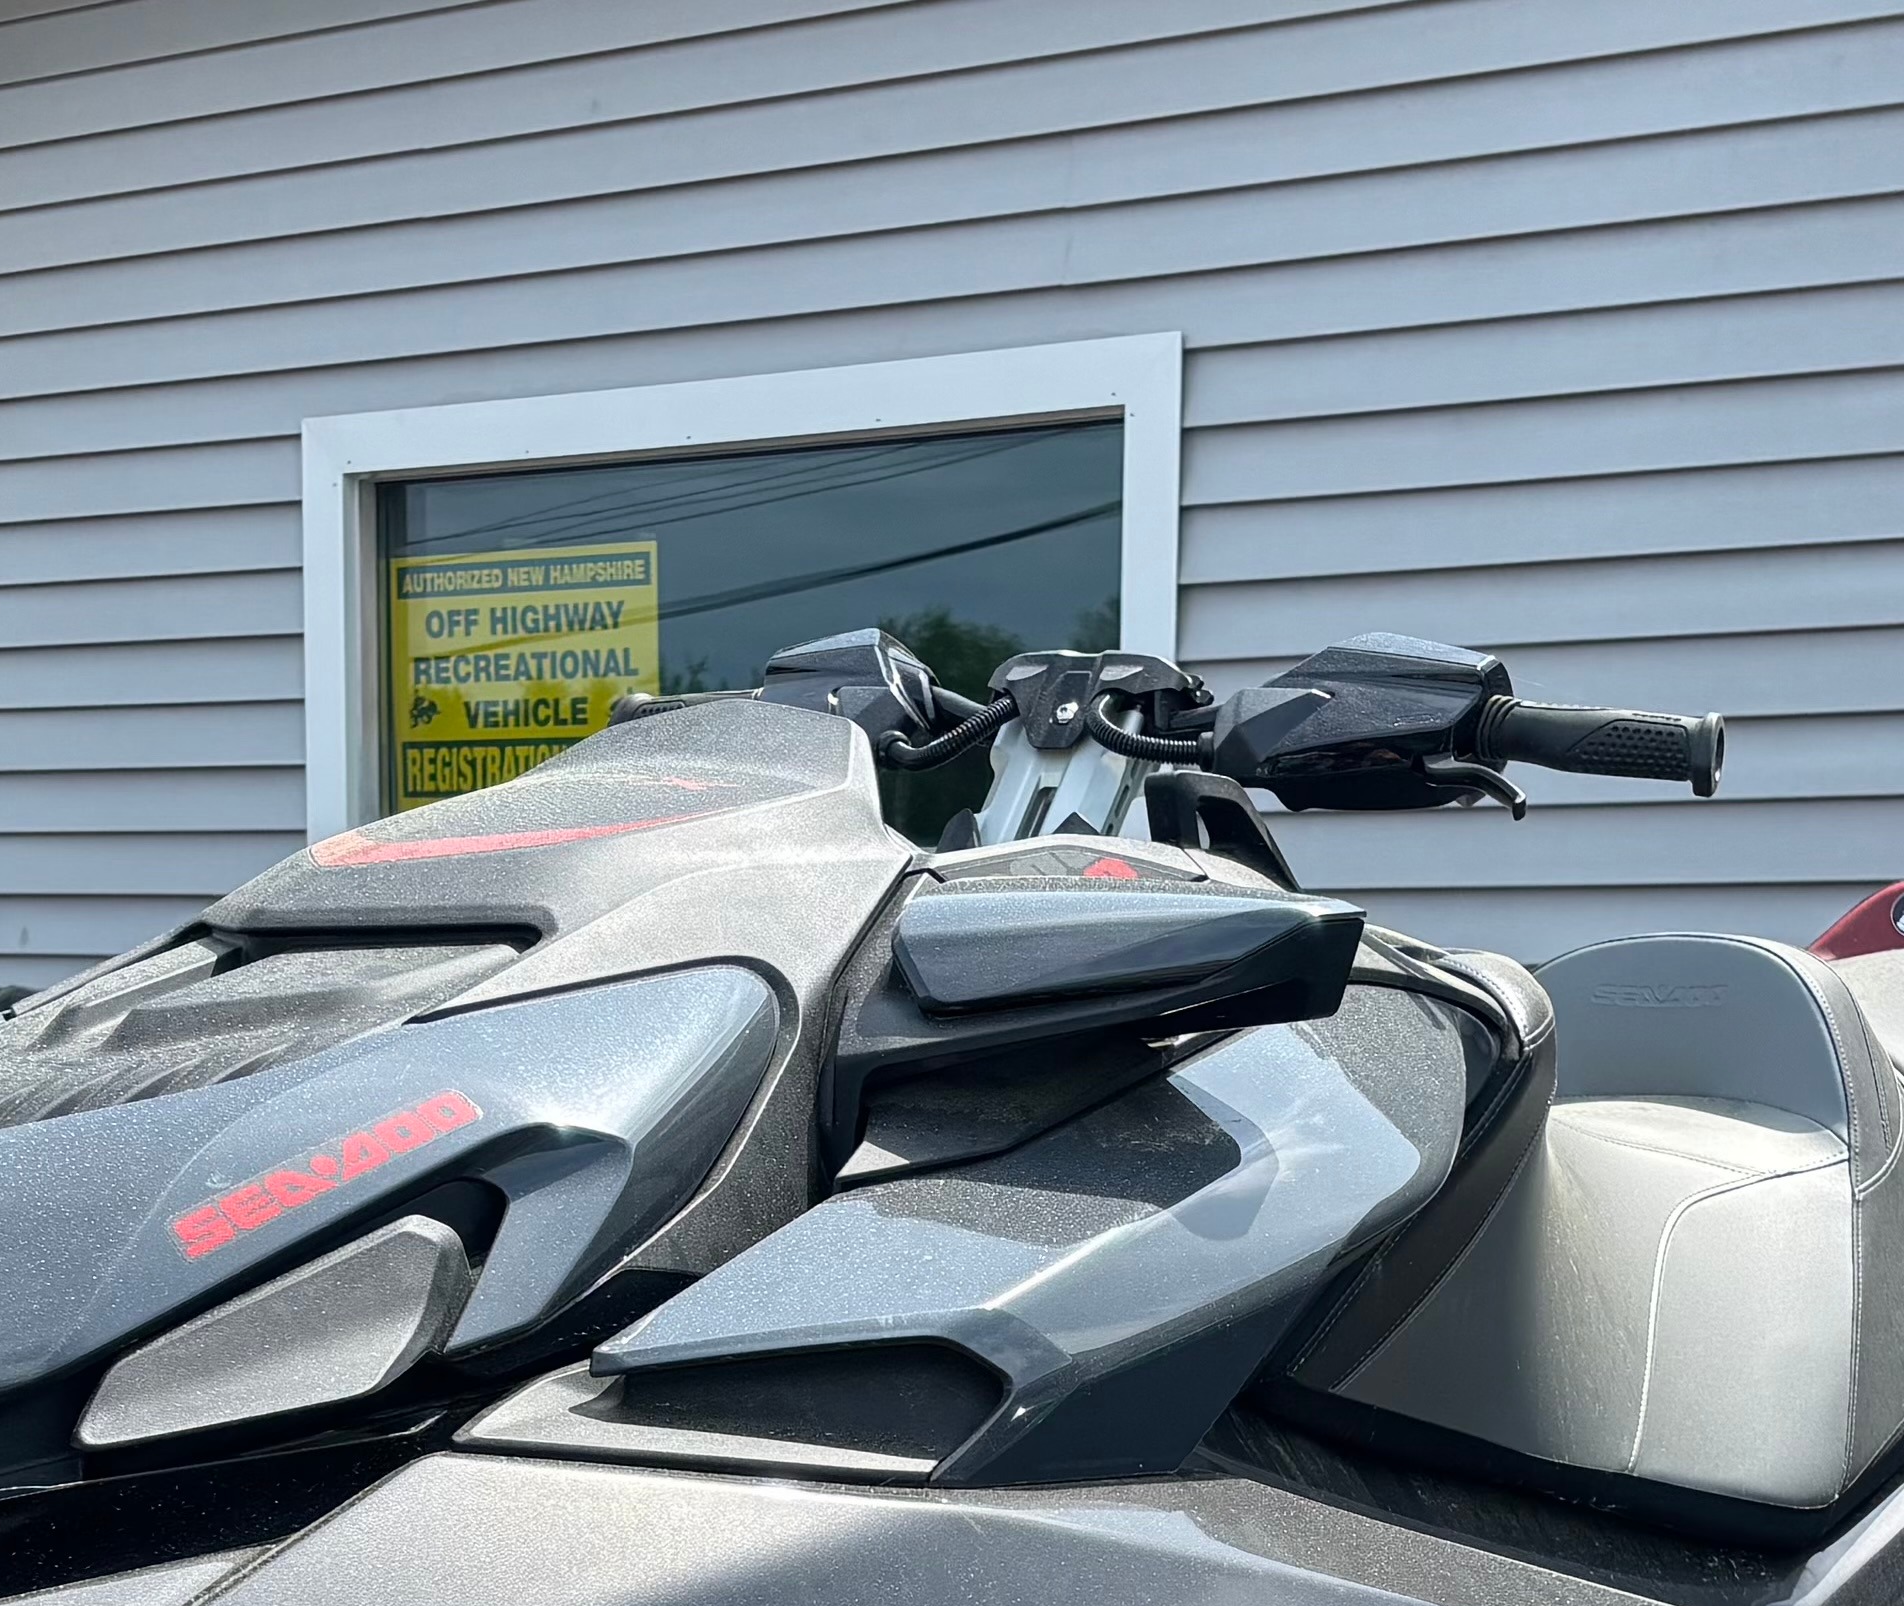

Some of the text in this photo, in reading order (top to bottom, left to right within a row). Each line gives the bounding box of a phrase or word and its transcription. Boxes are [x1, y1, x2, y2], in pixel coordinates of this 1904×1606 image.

[402, 559, 646, 594] AUTHORIZED NEW HAMPSHIRE
[425, 600, 625, 639] OFF HIGHWAY
[414, 647, 639, 684] RECREATIONAL
[464, 697, 588, 729] VEHICLE
[408, 745, 568, 792] REGISTRATI
